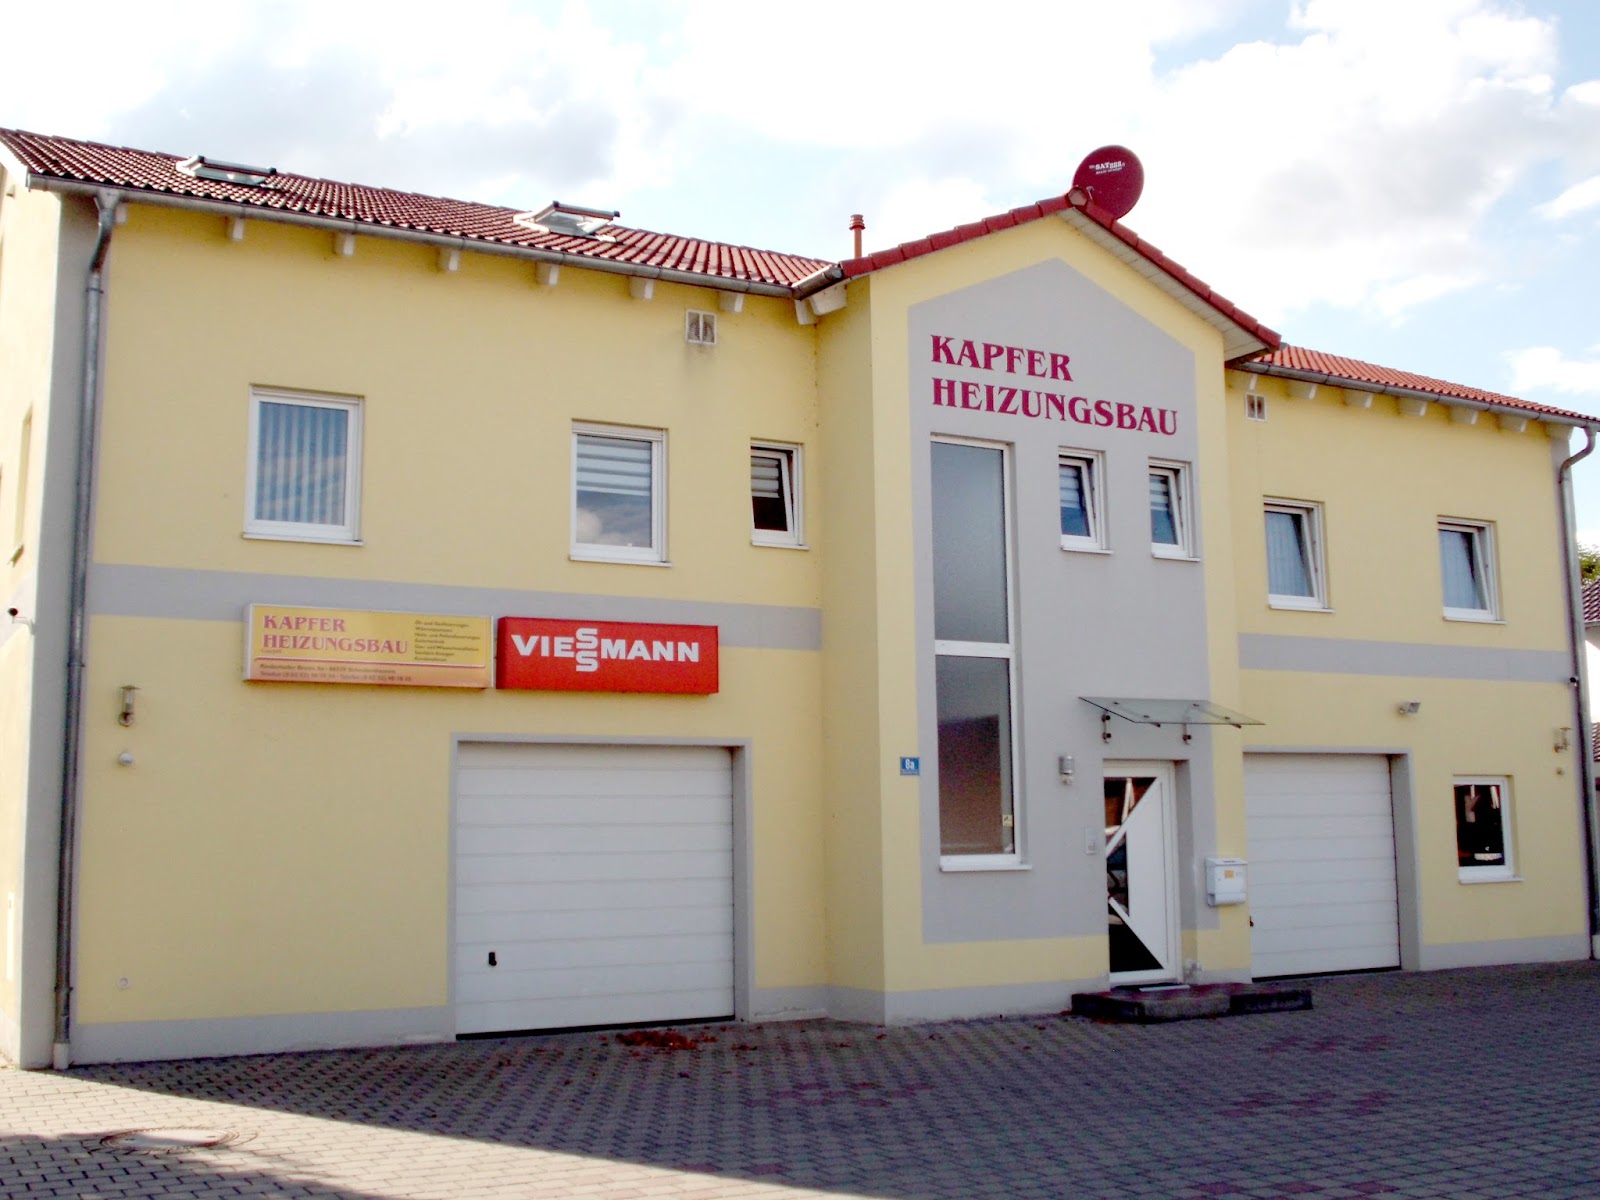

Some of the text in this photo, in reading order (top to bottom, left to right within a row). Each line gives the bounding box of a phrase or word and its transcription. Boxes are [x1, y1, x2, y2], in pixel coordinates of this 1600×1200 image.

[930, 334, 1074, 382] KAPFER
[931, 377, 1178, 435] HEIZUNGSBAU
[262, 634, 408, 654] HEIZUNGSBAU
[263, 615, 346, 632] KAPFER
[510, 627, 700, 672] VIESSMANN
